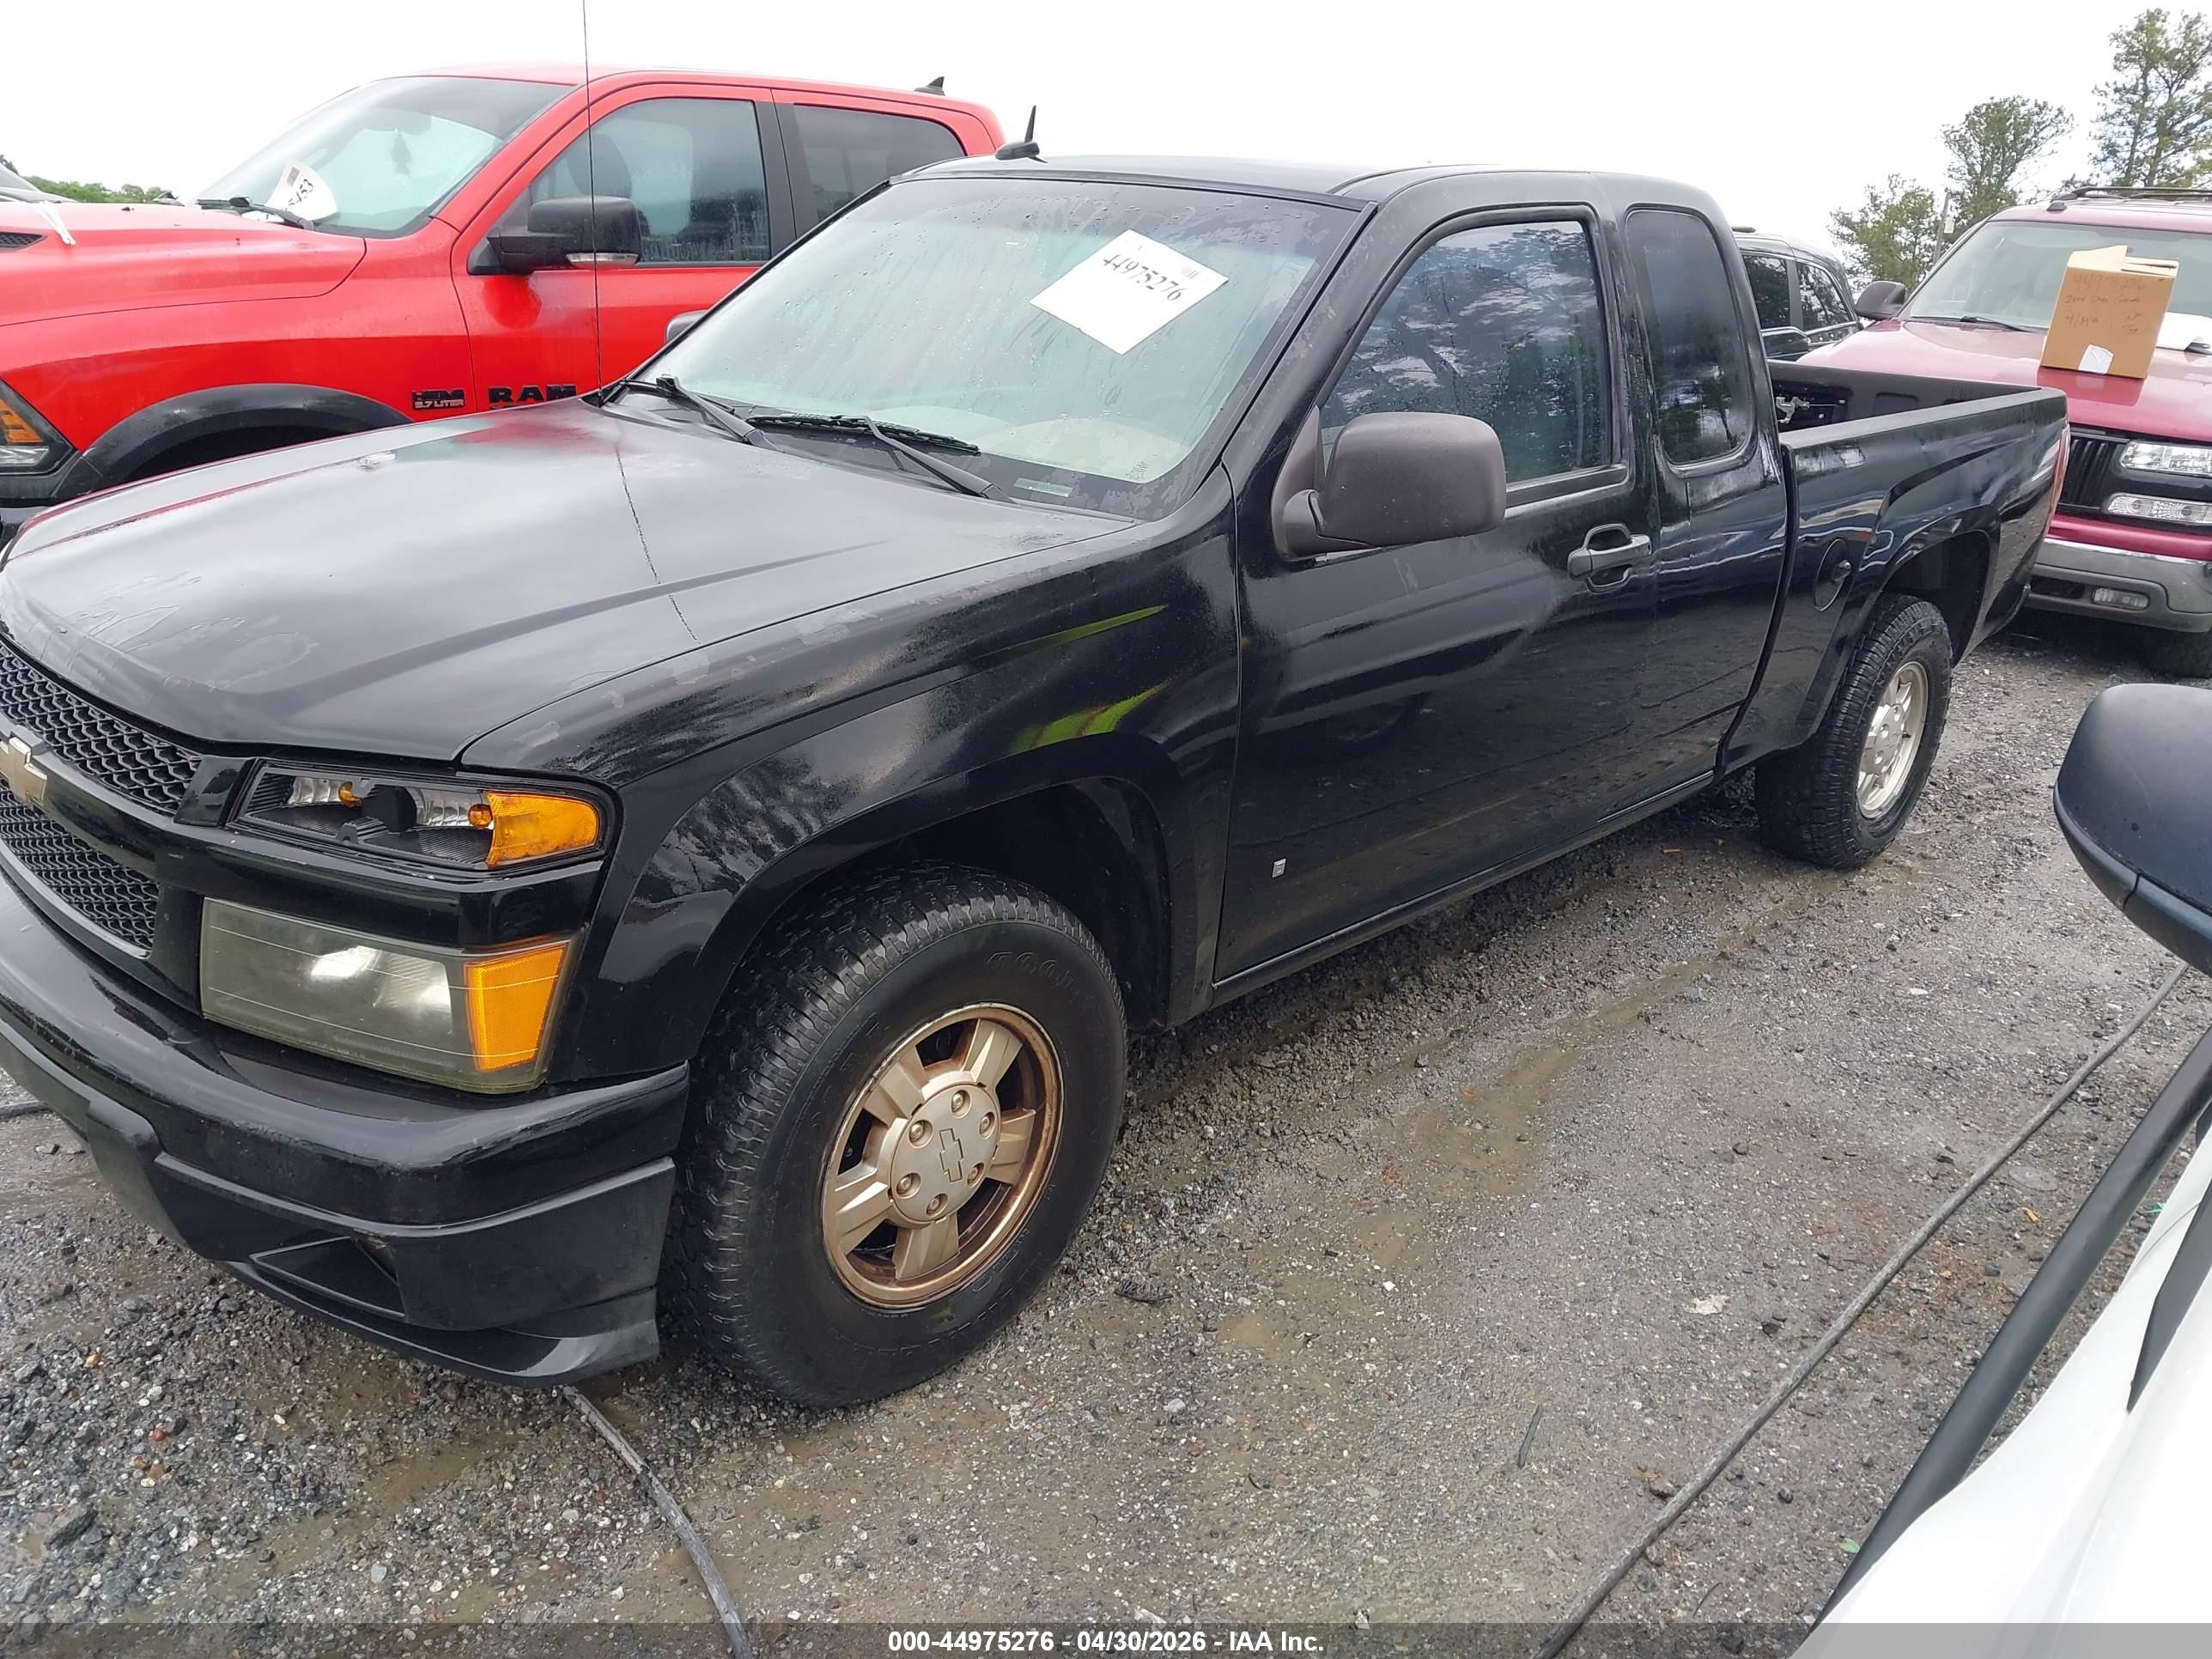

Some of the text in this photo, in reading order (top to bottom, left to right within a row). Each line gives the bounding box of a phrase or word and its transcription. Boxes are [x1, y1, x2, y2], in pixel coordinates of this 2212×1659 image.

[1102, 252, 1188, 302] 44975276
[434, 398, 465, 408] LITER
[487, 384, 577, 404] RAM
